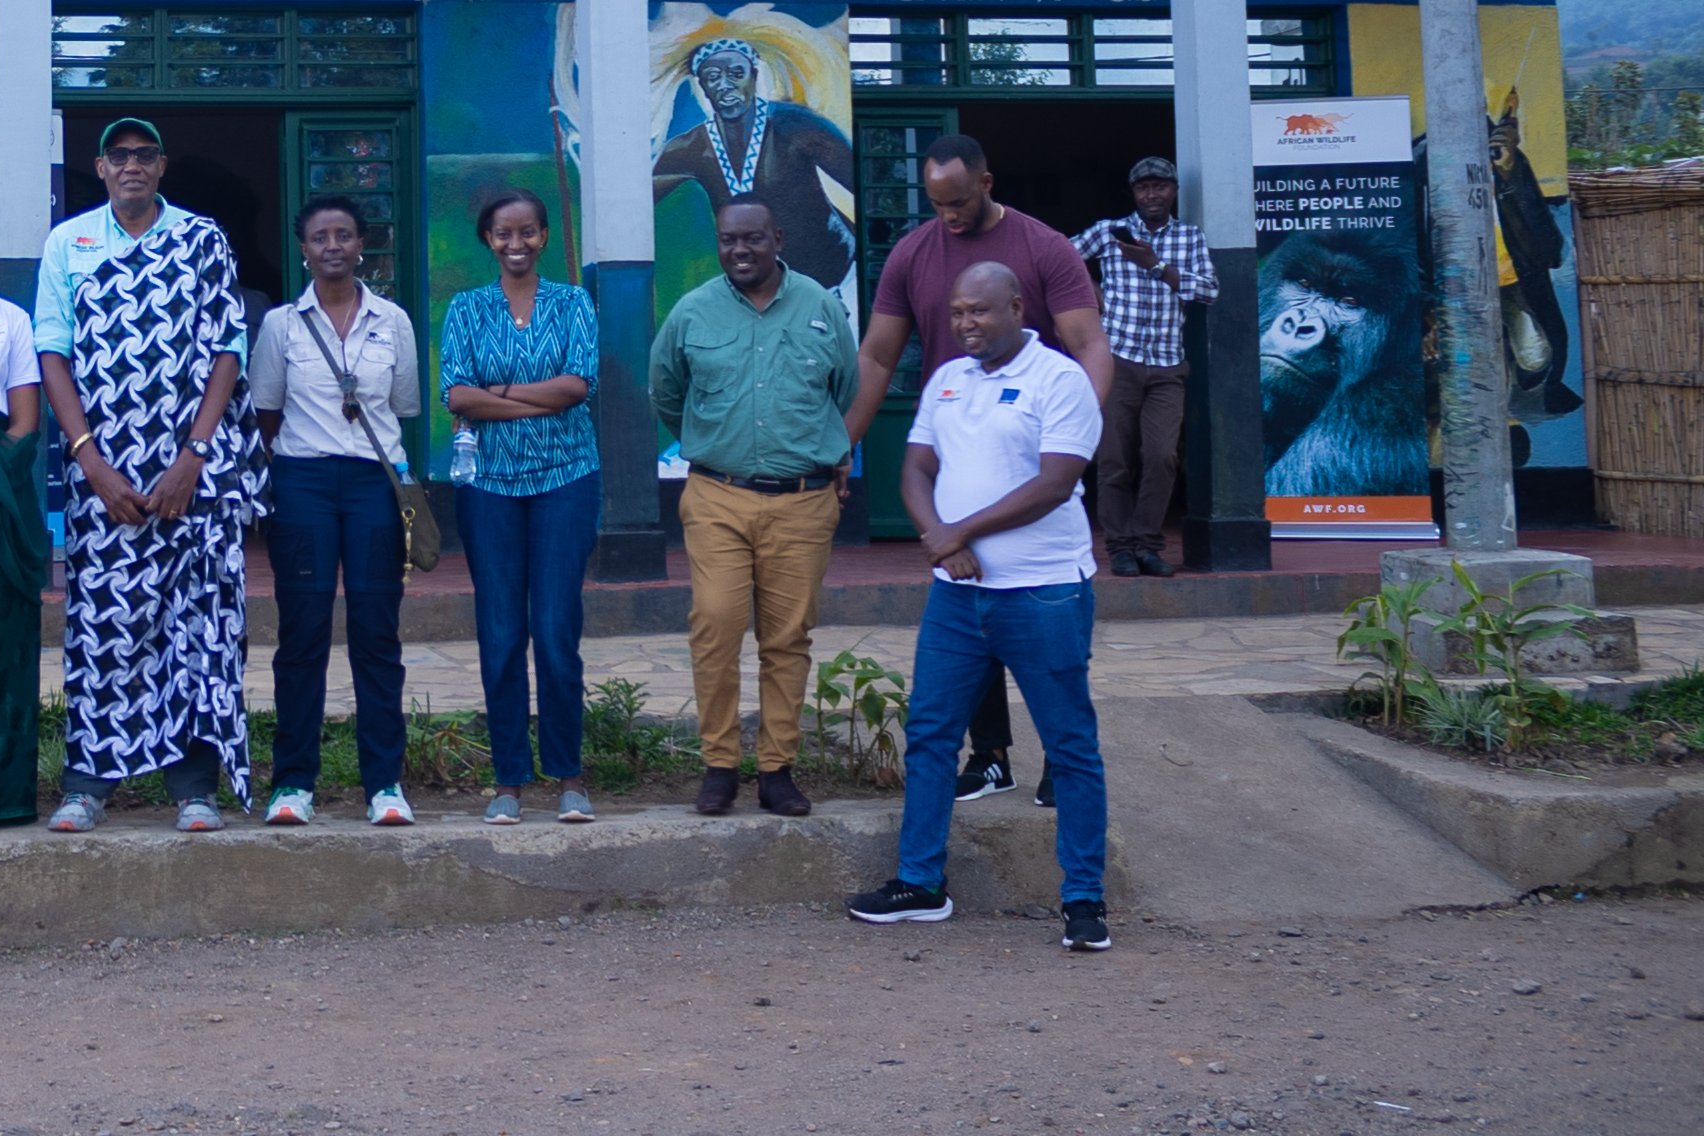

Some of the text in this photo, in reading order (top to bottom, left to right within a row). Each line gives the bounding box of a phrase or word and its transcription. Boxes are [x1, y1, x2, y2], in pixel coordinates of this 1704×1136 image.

[1276, 135, 1356, 145] AFRICAN WILDLIFE
[1319, 178, 1331, 190] A
[1335, 176, 1401, 190] FUTURE
[1255, 196, 1401, 212] HERE PEOPLE AND
[1336, 216, 1395, 229] THRIVE
[1303, 504, 1366, 514] AWF.ORG
